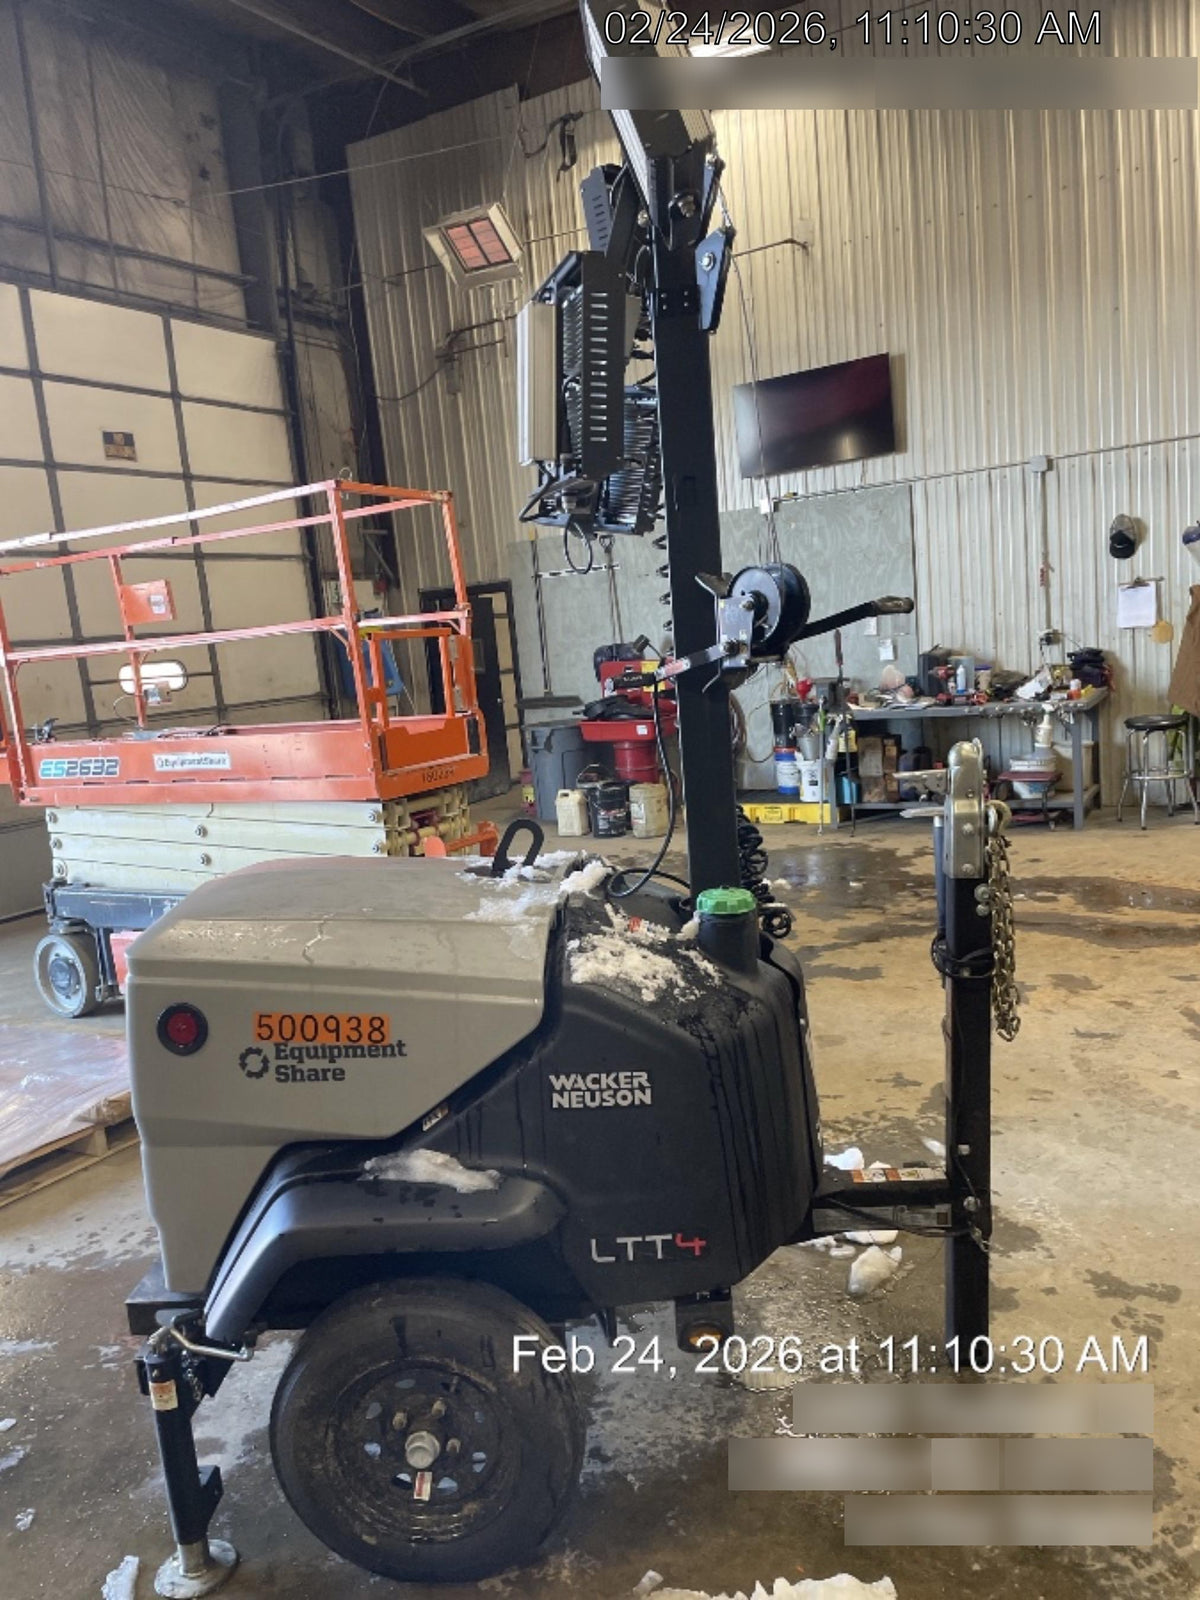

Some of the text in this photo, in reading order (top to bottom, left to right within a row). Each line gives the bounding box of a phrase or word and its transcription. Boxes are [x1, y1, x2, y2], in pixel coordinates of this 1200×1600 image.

[40, 759, 119, 777] ES2632
[257, 1014, 386, 1044] 500938
[274, 1040, 407, 1063] Equipment
[275, 1064, 346, 1083] Share
[549, 1071, 651, 1091] WACKER
[552, 1088, 652, 1109] NEUSON
[590, 1232, 707, 1264] LTT4
